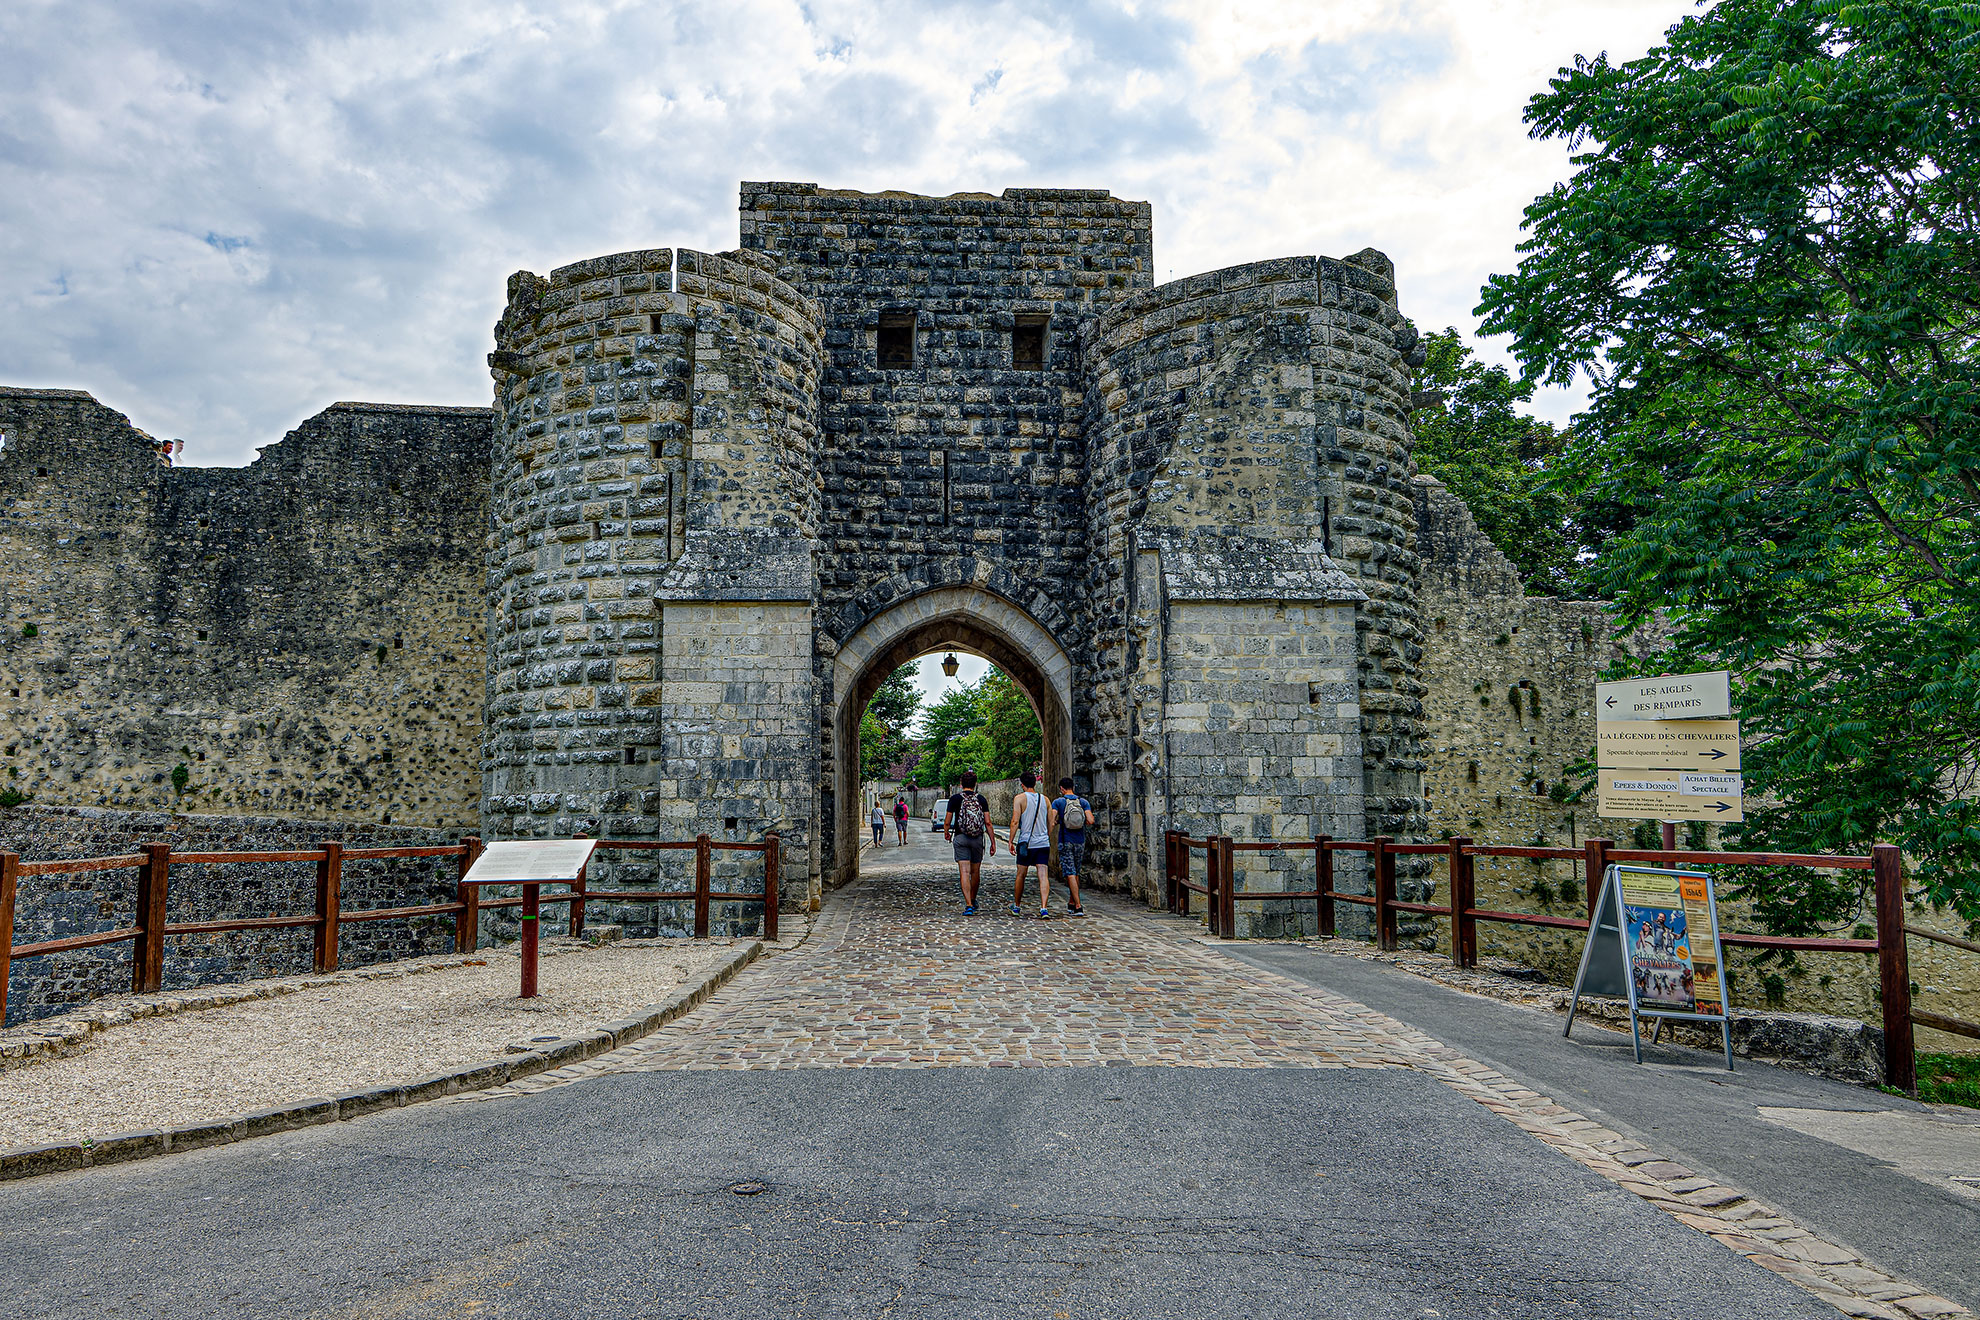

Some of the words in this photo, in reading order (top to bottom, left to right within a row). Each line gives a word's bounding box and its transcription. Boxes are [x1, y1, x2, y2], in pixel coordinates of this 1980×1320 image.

[1640, 687, 1657, 696] LES
[1659, 684, 1693, 695] AIGLES
[1633, 703, 1651, 712] DES
[1653, 698, 1702, 710] REMPARTS
[1613, 731, 1657, 740] LÉGENDE
[1677, 733, 1737, 741] CHEVALIERS
[1606, 749, 1634, 757] Spectacle
[1684, 775, 1708, 783] ACHAT
[1709, 775, 1736, 783] BILLETS
[1613, 781, 1636, 790] EPEES
[1636, 782, 1645, 790] &
[1646, 782, 1677, 791] DONJON
[1691, 785, 1729, 794] SPECTACLE
[1685, 888, 1703, 898] 15h45
